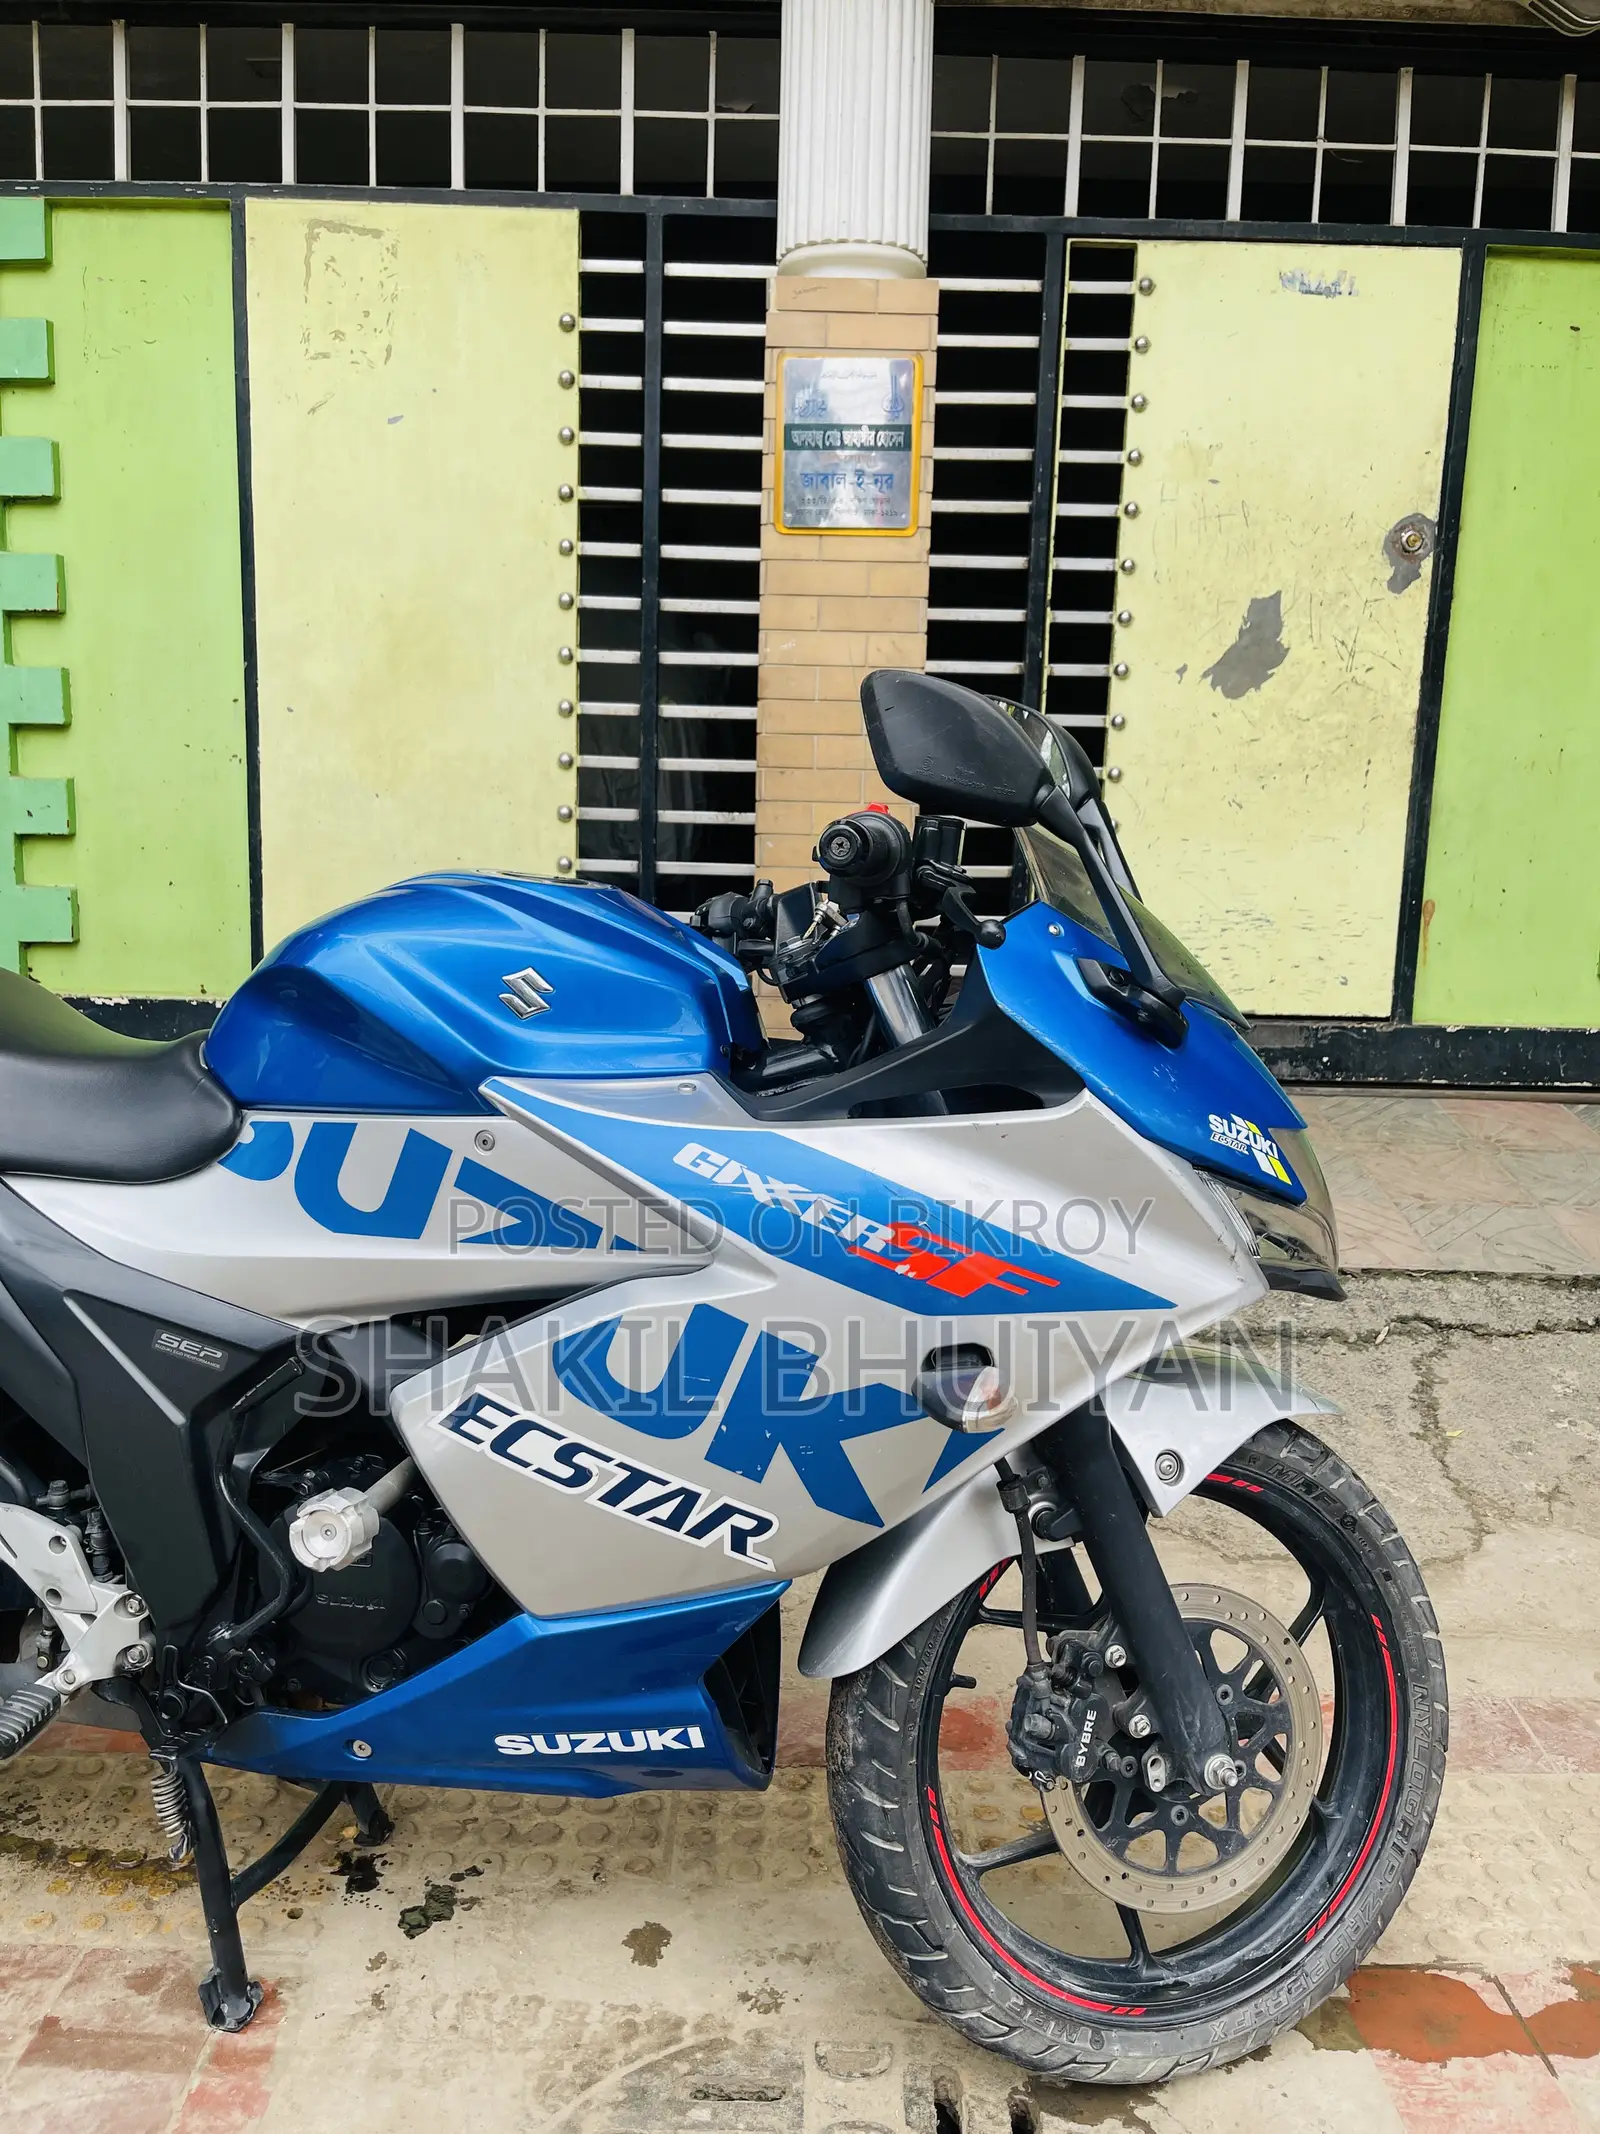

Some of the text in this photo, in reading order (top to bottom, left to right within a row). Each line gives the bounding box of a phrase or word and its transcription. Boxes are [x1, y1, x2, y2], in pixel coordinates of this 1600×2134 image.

[1208, 1113, 1279, 1160] SUZUKI
[1211, 1132, 1249, 1154] ECSTAR
[672, 1142, 892, 1252] GIXXER
[157, 1333, 223, 1359] SEP
[441, 1391, 772, 1567] ECSTAR
[1266, 1462, 1340, 1510] MRF
[494, 1726, 705, 1755] SUZUKI
[1075, 1708, 1098, 1767] BYBRE
[1381, 1682, 1431, 1886] NYLOGRIP
